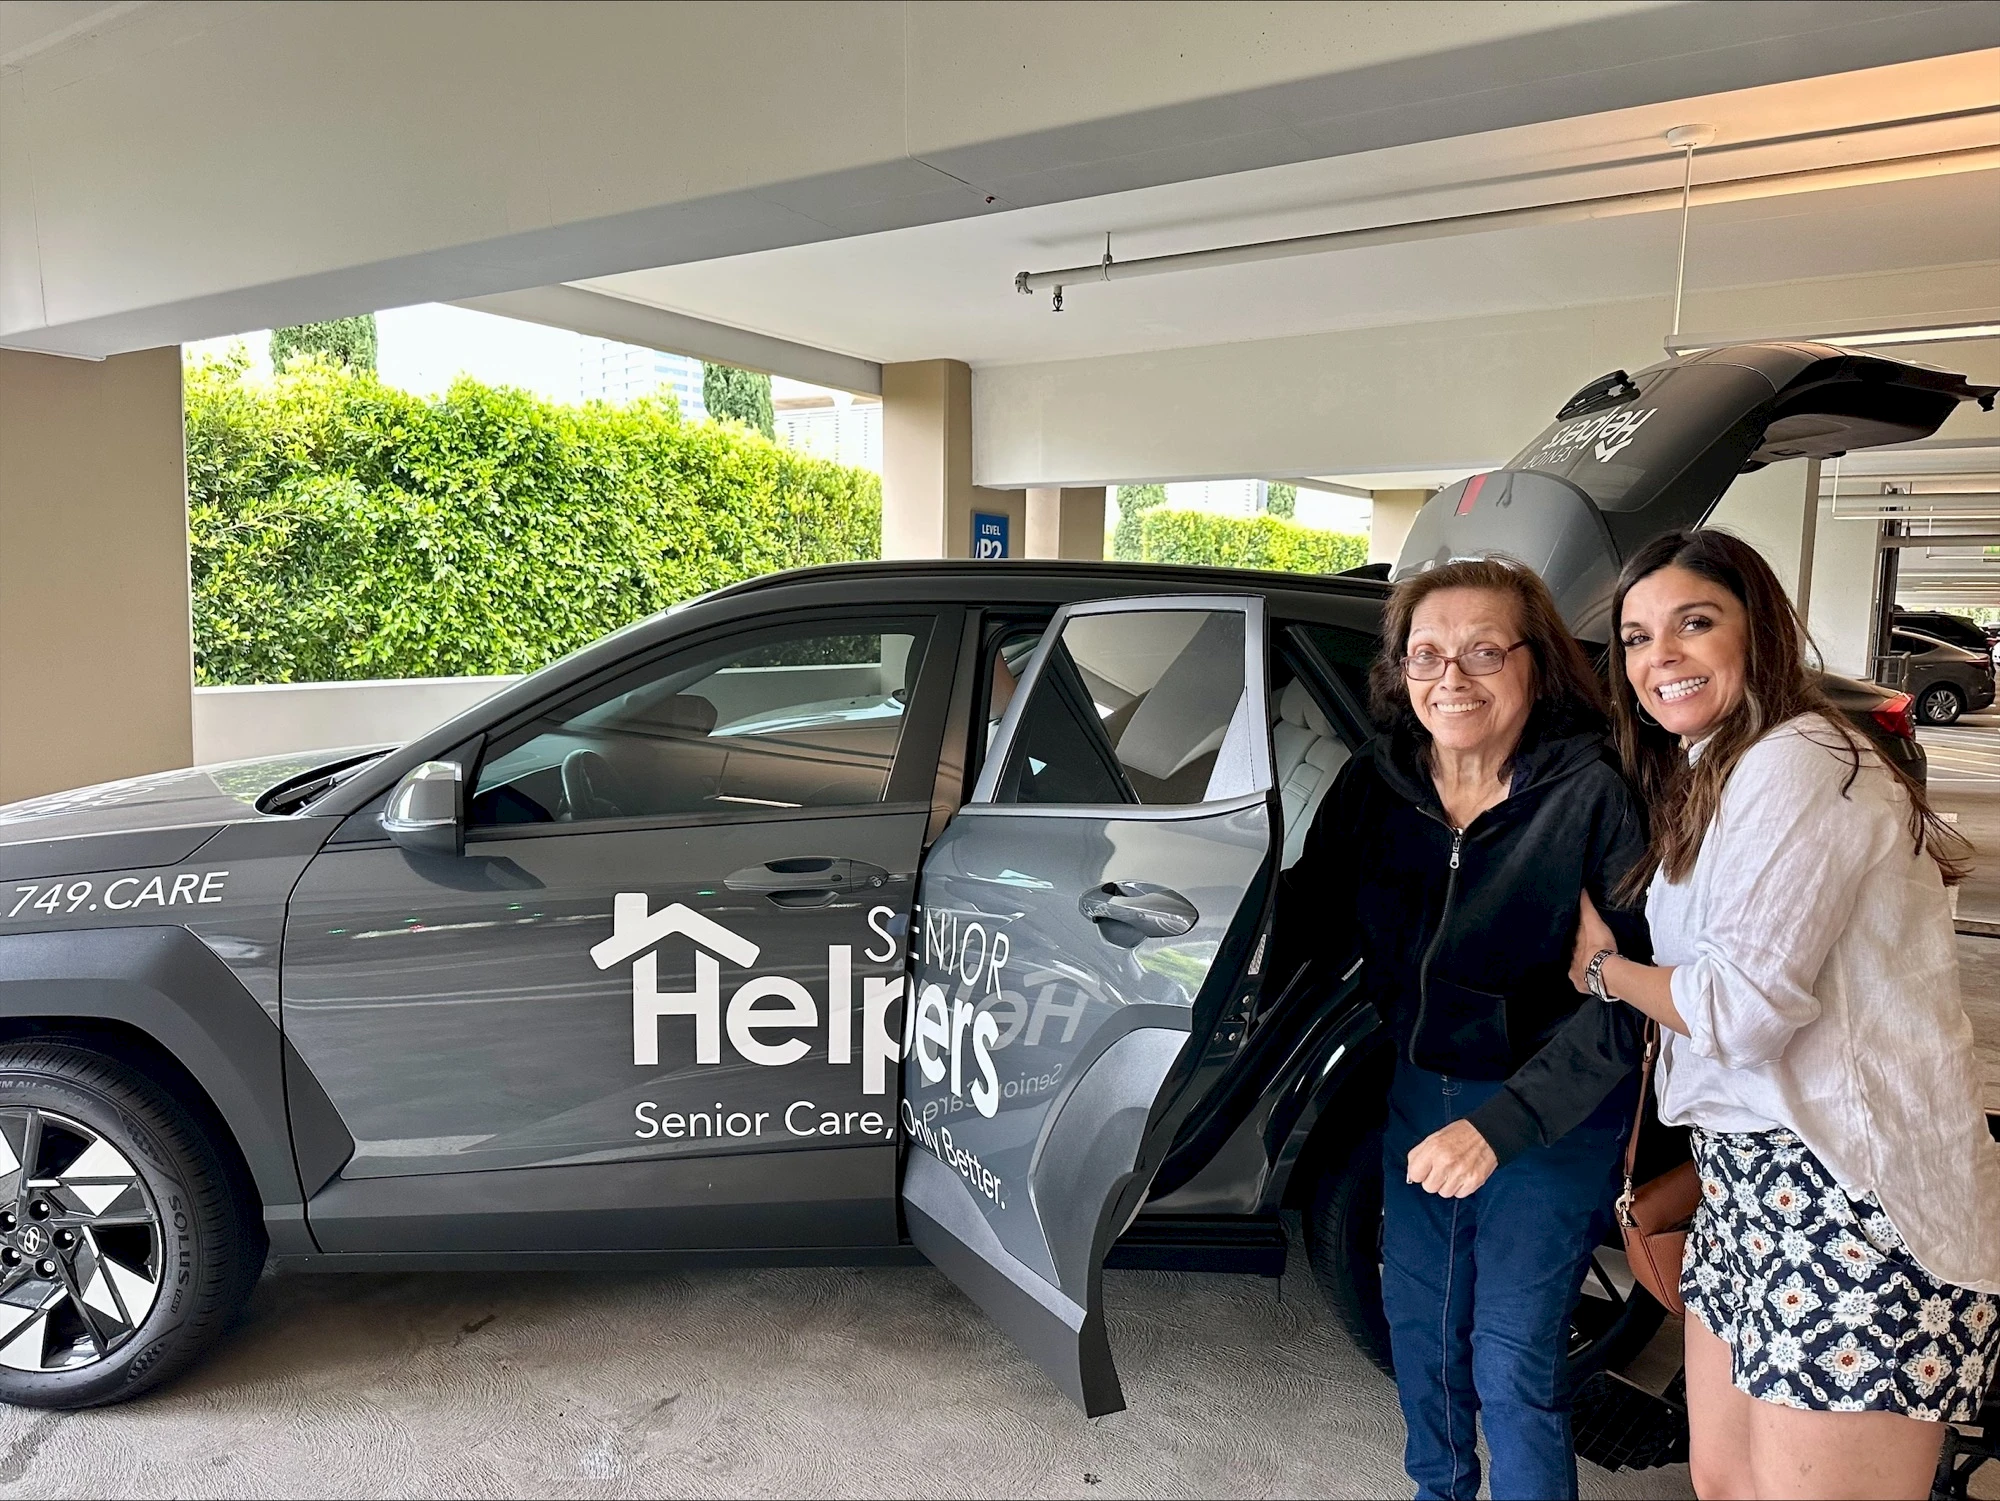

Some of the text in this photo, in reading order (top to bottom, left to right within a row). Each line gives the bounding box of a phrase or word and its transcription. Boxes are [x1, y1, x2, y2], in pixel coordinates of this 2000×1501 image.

[1522, 445, 1579, 469] SENIOR
[1542, 406, 1658, 450] Helpers
[982, 524, 1001, 535] LEVEL
[0, 871, 229, 918] 749.CARE
[865, 905, 1010, 1000] SENIOR
[632, 944, 1000, 1119] Helpers
[634, 1098, 1006, 1210] Senior Care, Only Better.
[168, 1195, 191, 1285] SOLUS
